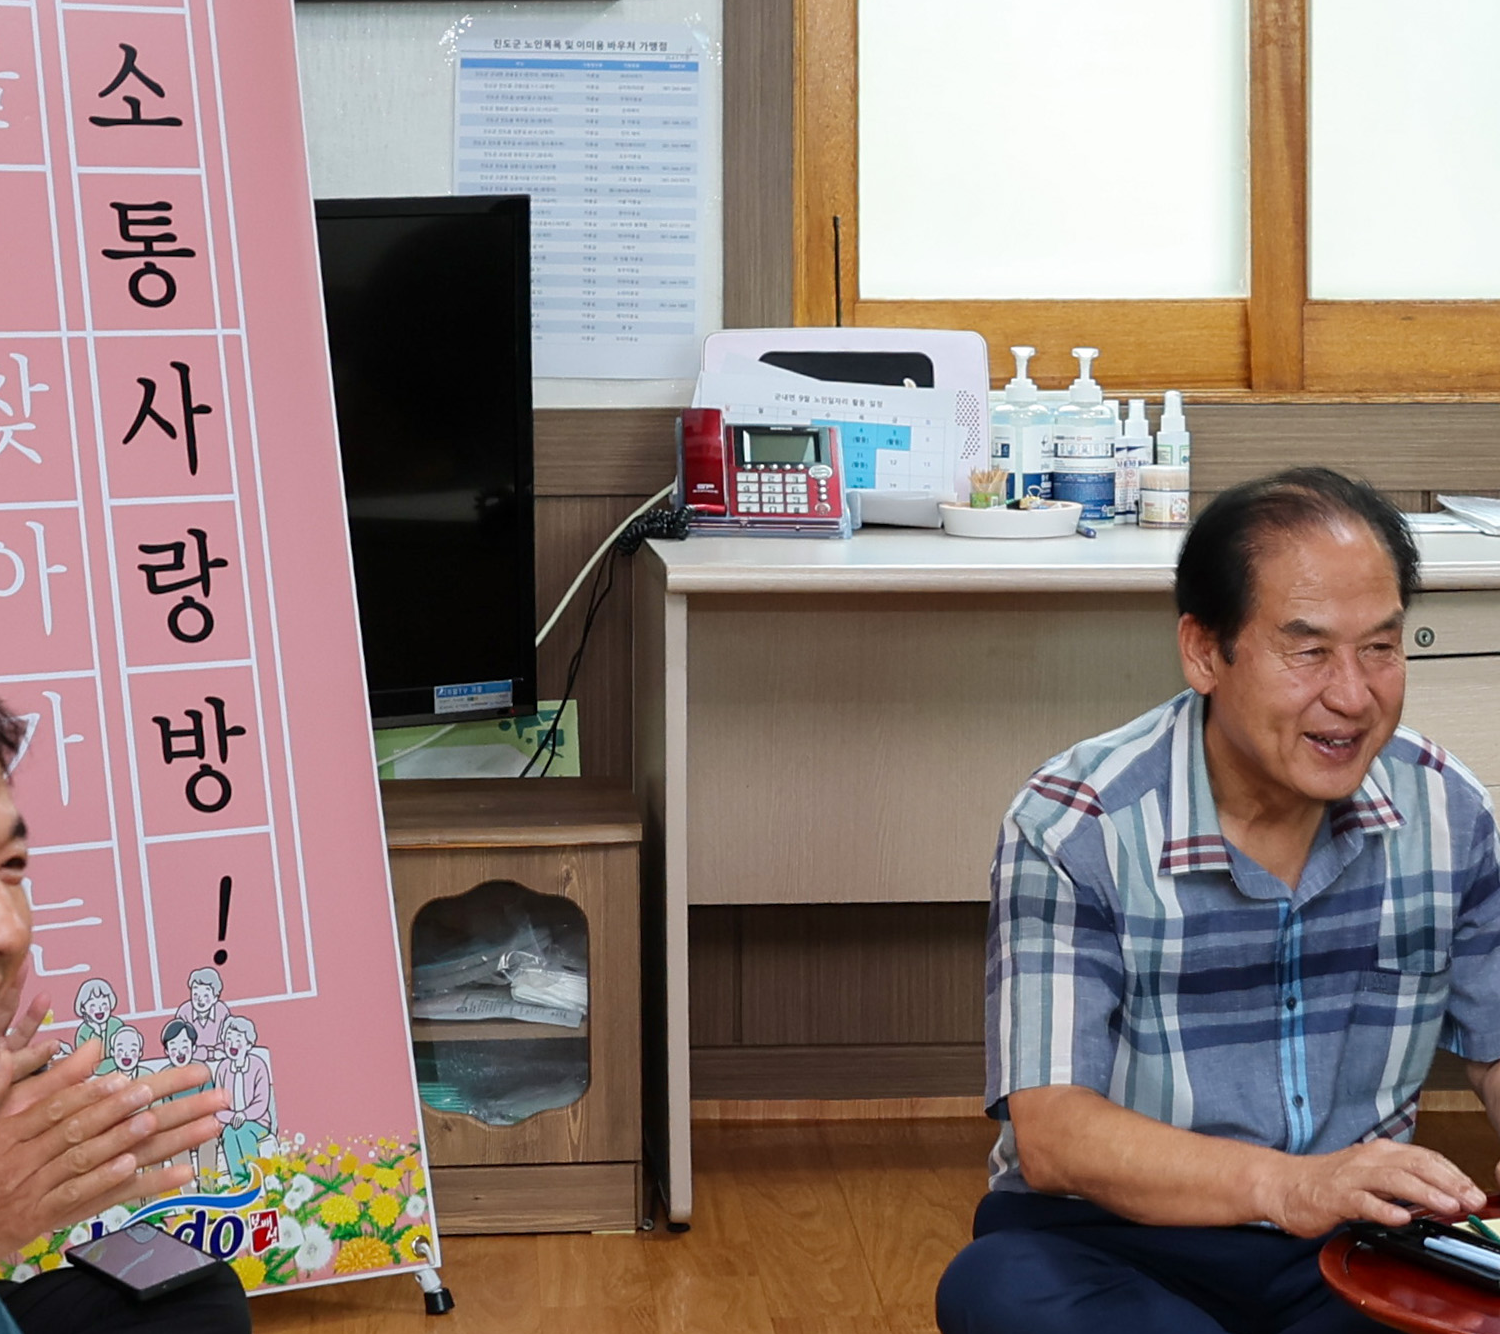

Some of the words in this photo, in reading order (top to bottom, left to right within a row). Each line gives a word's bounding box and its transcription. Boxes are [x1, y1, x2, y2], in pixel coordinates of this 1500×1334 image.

[493, 39, 522, 50] 진도군
[576, 40, 605, 51] 이미용
[607, 40, 636, 51] 바우처
[638, 41, 668, 52] 가맹점
